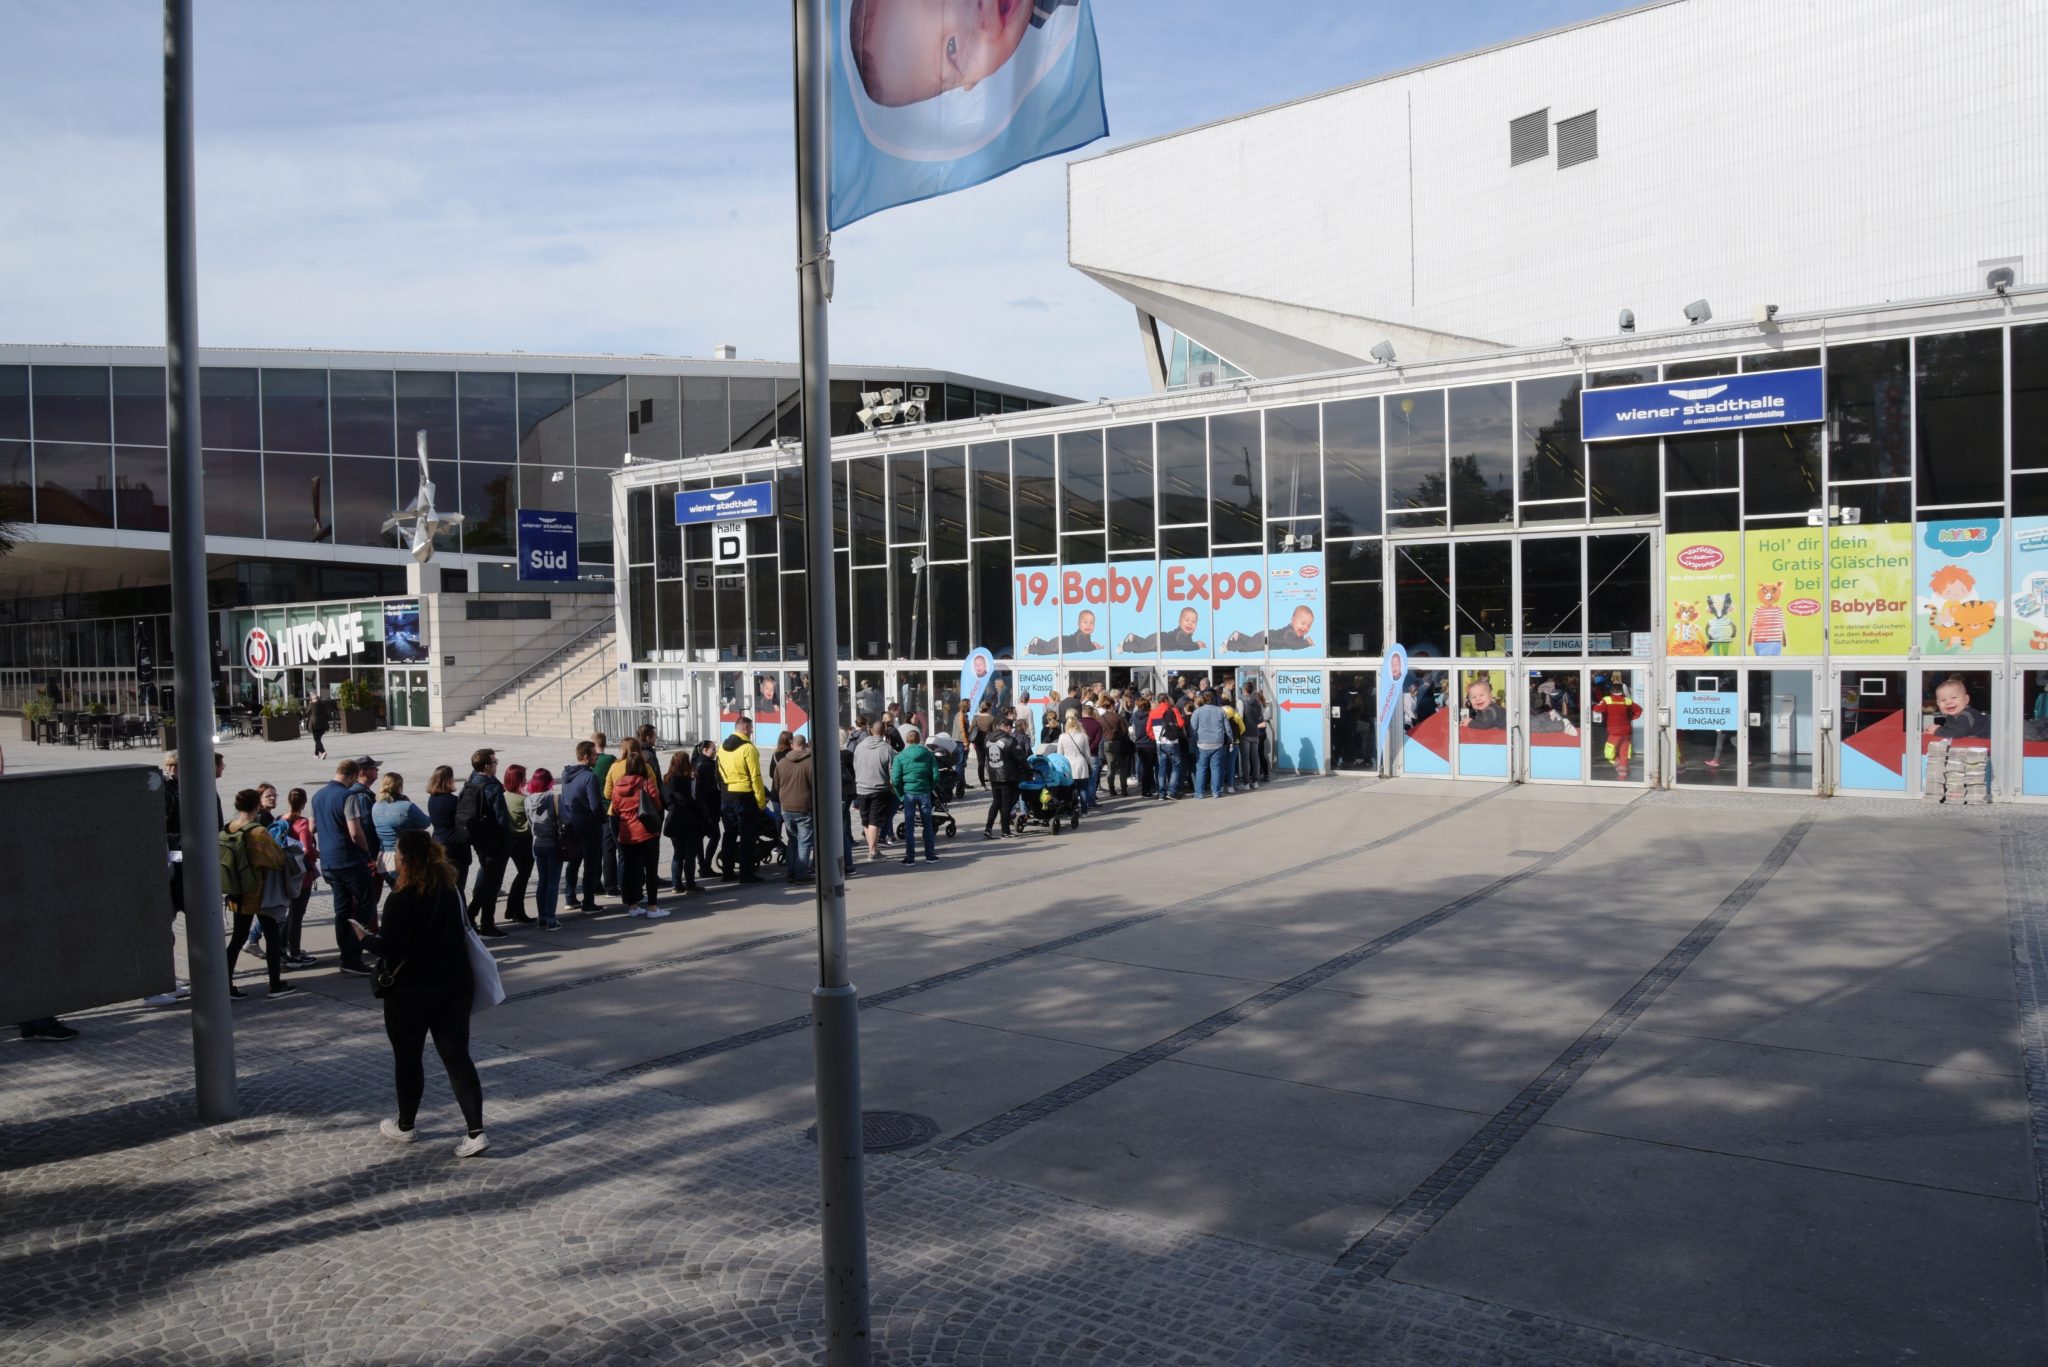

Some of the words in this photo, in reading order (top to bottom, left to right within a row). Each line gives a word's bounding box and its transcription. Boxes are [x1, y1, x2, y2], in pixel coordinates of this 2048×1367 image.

[1616, 407, 1679, 421] wiener
[1683, 395, 1785, 416] stadthalle
[1694, 415, 1732, 424] unternehmen
[689, 503, 716, 513] wiener
[716, 498, 758, 511] stadthalle
[716, 523, 741, 534] halle
[719, 536, 741, 560] D
[1797, 537, 1820, 550] dir
[1831, 536, 1867, 550] dein
[530, 549, 568, 569] Süd
[1015, 572, 1058, 607] 19.
[1062, 566, 1153, 613] Baby
[1167, 565, 1262, 611] Expo
[1795, 577, 1820, 590] bei
[1831, 576, 1859, 590] der
[1831, 598, 1907, 616] BabyBar
[276, 610, 365, 667] HITCAFE
[1553, 639, 1594, 649] EINGAG
[1020, 674, 1053, 682] EINGANG
[1278, 675, 1321, 684] EINGANG
[1279, 686, 1292, 695] mit
[1683, 707, 1731, 715] AUSSTELLER
[1688, 717, 1726, 725] EINGANG
